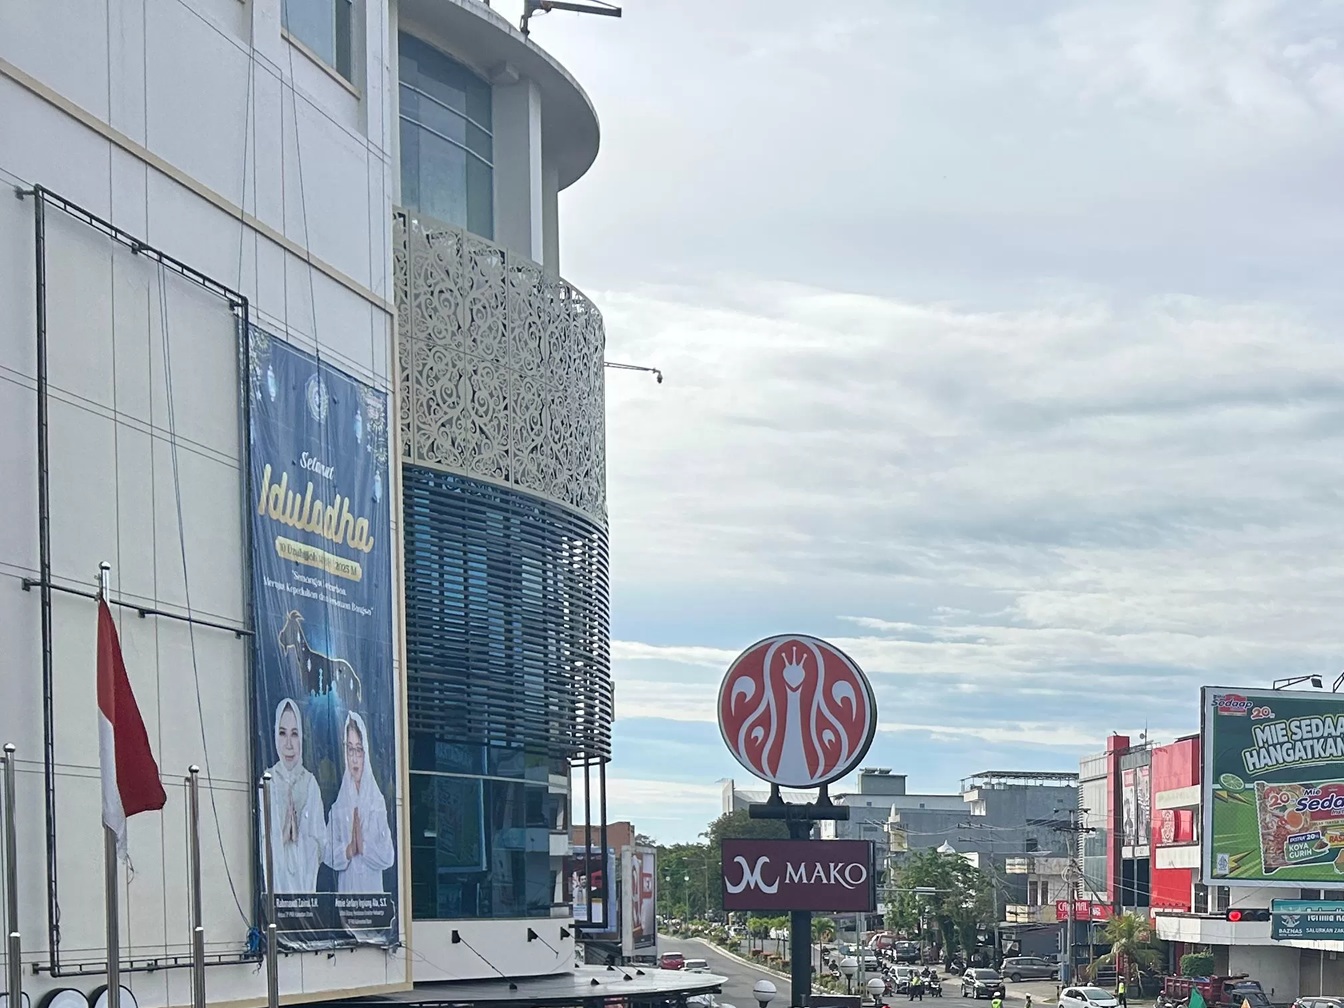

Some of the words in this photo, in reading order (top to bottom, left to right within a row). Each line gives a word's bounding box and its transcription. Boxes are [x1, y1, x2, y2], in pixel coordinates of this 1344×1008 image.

[300, 451, 336, 480] Selamat
[258, 464, 374, 553] Iduladha
[1254, 723, 1288, 748] MIE
[1304, 788, 1321, 796] Mie
[1289, 843, 1309, 851] KOYA
[1289, 850, 1312, 859] GURIH
[785, 861, 867, 890] MAKO
